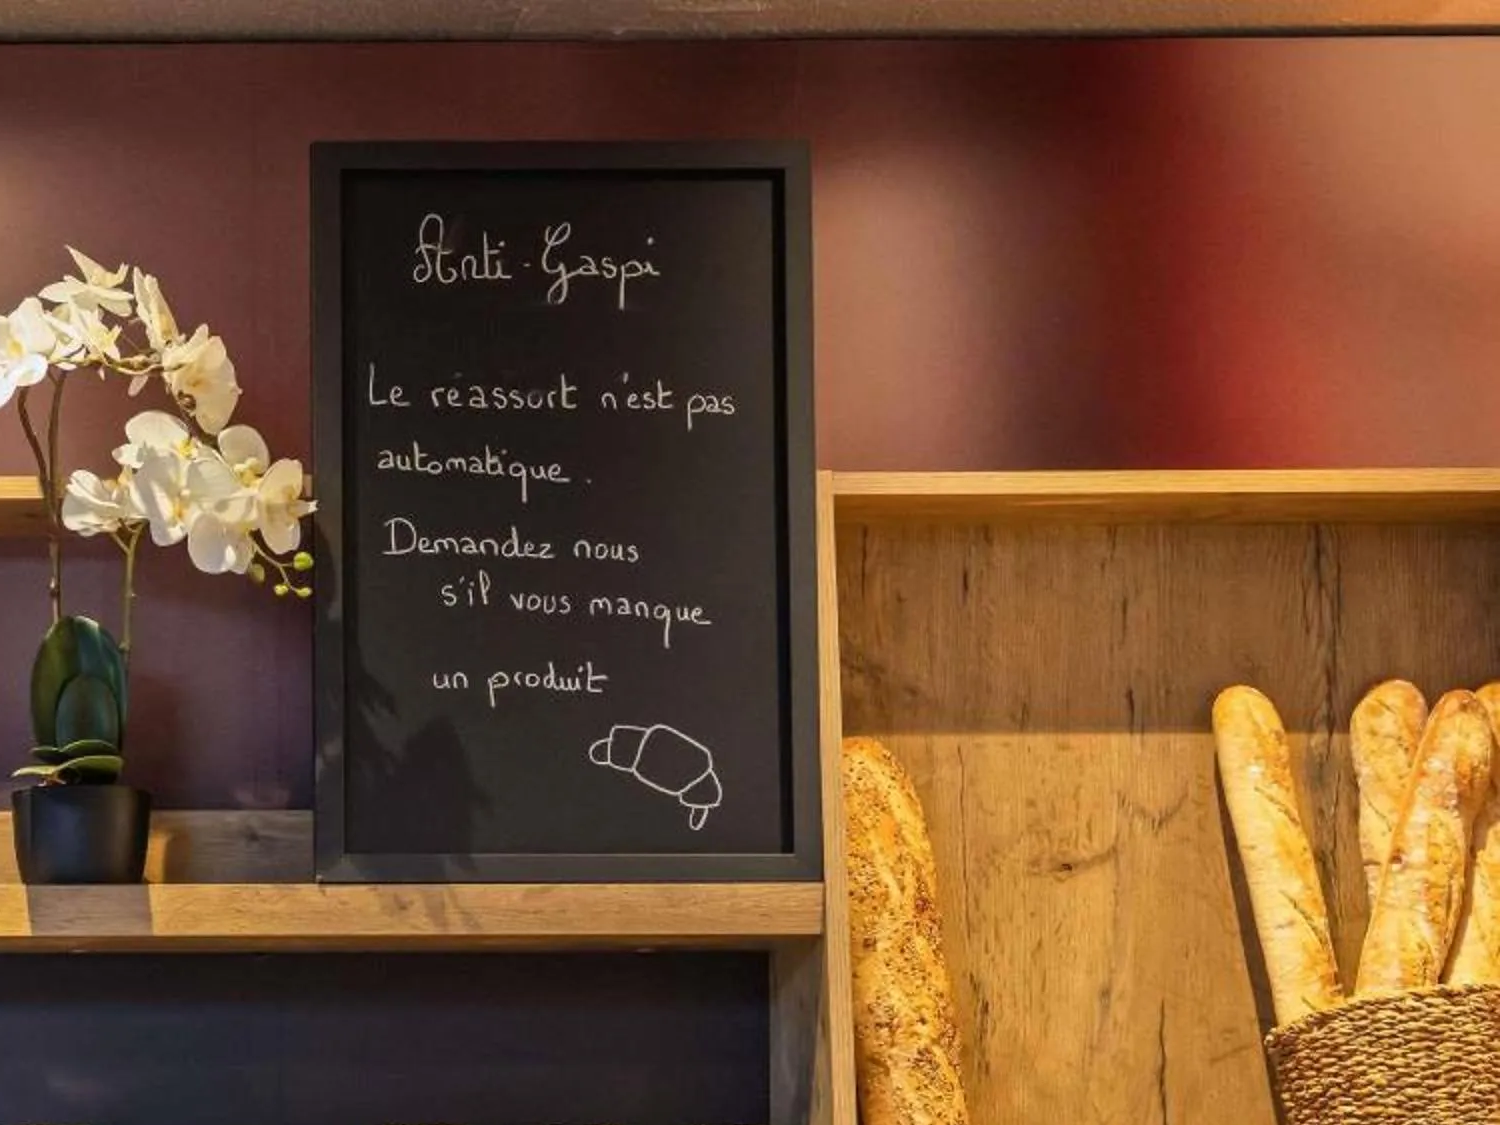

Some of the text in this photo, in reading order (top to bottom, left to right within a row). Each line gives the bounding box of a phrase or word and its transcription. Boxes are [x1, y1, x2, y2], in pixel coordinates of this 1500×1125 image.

[369, 363, 411, 407] Le
[601, 372, 674, 410] n'est
[687, 392, 736, 431] pas
[383, 517, 640, 563] Demandez nous
[441, 570, 712, 649] s'il vous manque
[433, 660, 609, 708] un produit
